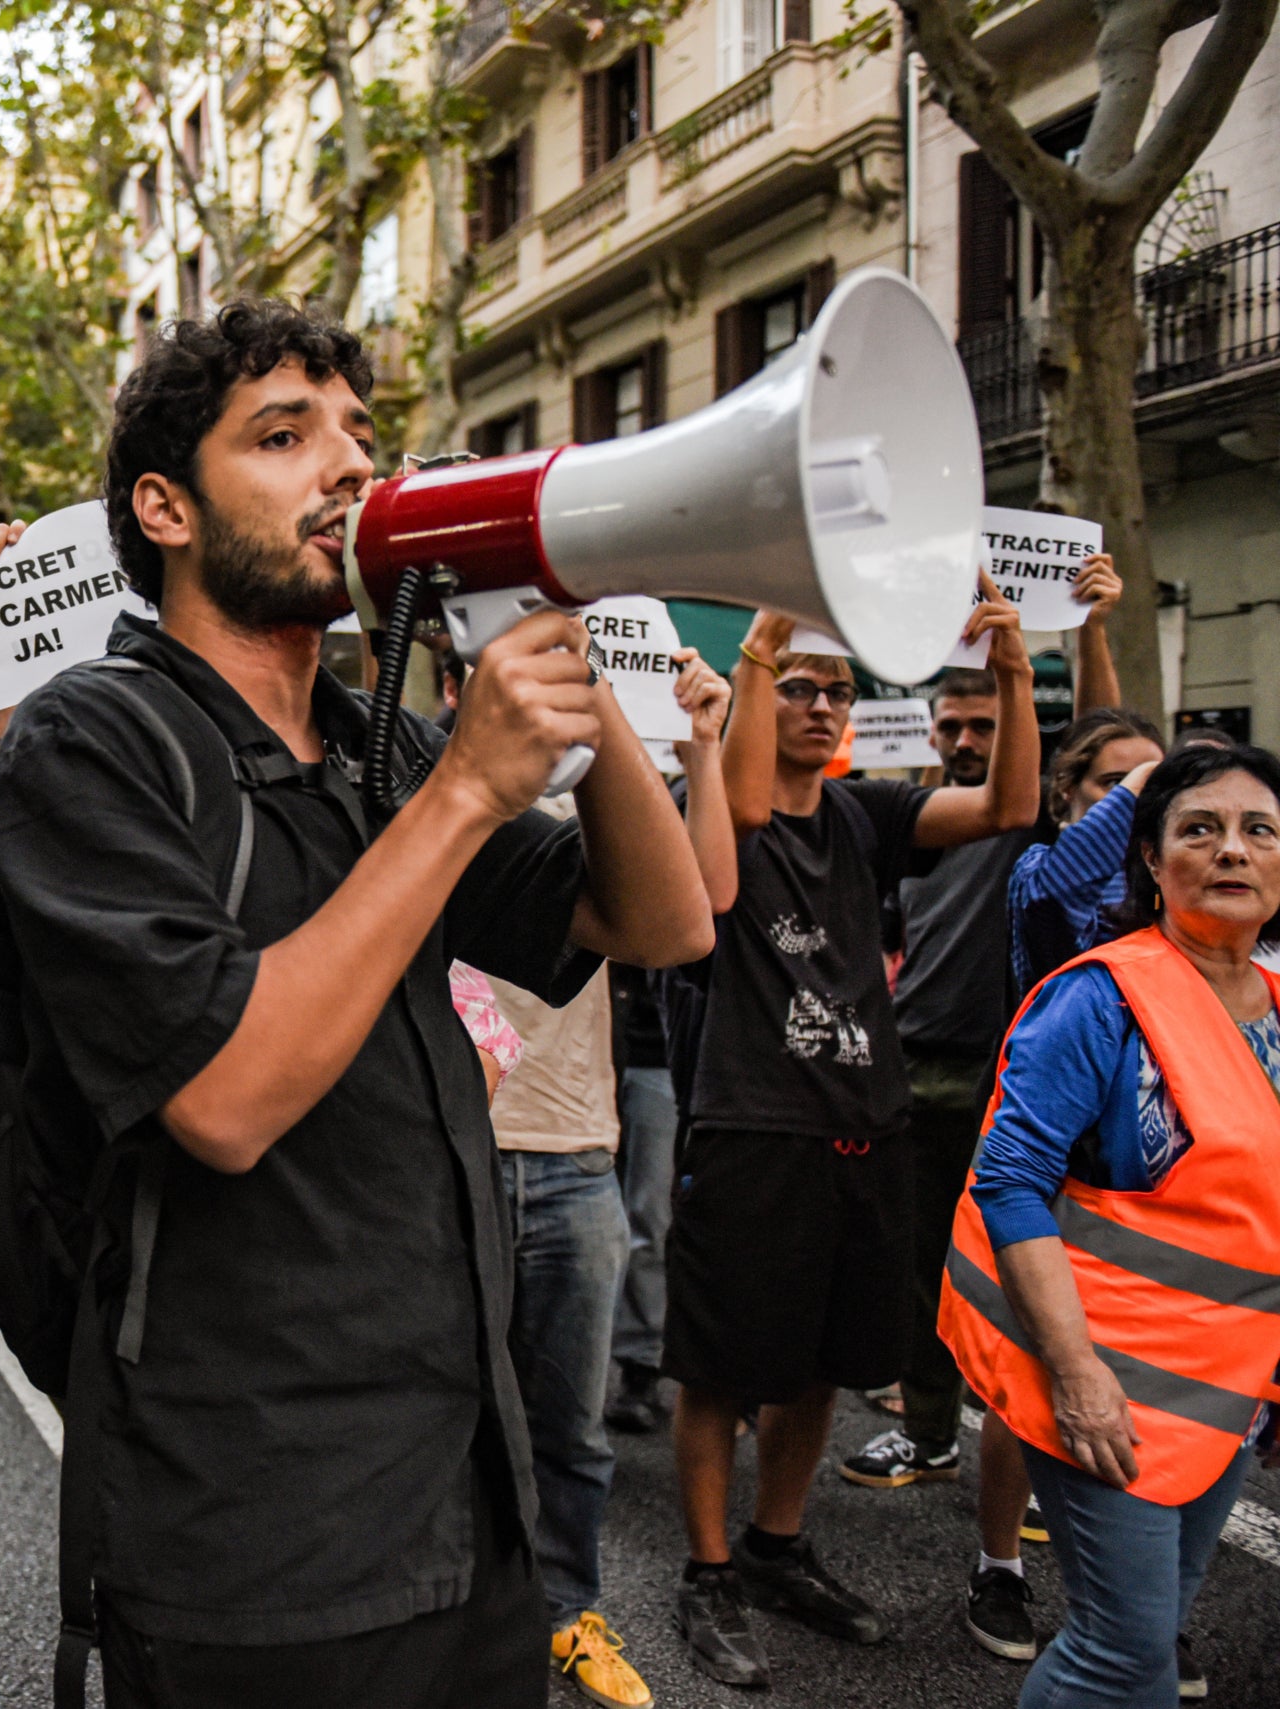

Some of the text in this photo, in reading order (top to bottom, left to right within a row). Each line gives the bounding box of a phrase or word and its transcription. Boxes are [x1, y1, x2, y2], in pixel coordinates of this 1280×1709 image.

[985, 532, 1096, 557] TRACTES
[991, 558, 1081, 583] EFINITS
[1001, 585, 1025, 603] A!
[585, 615, 650, 639] CRET
[14, 628, 64, 662] JA!
